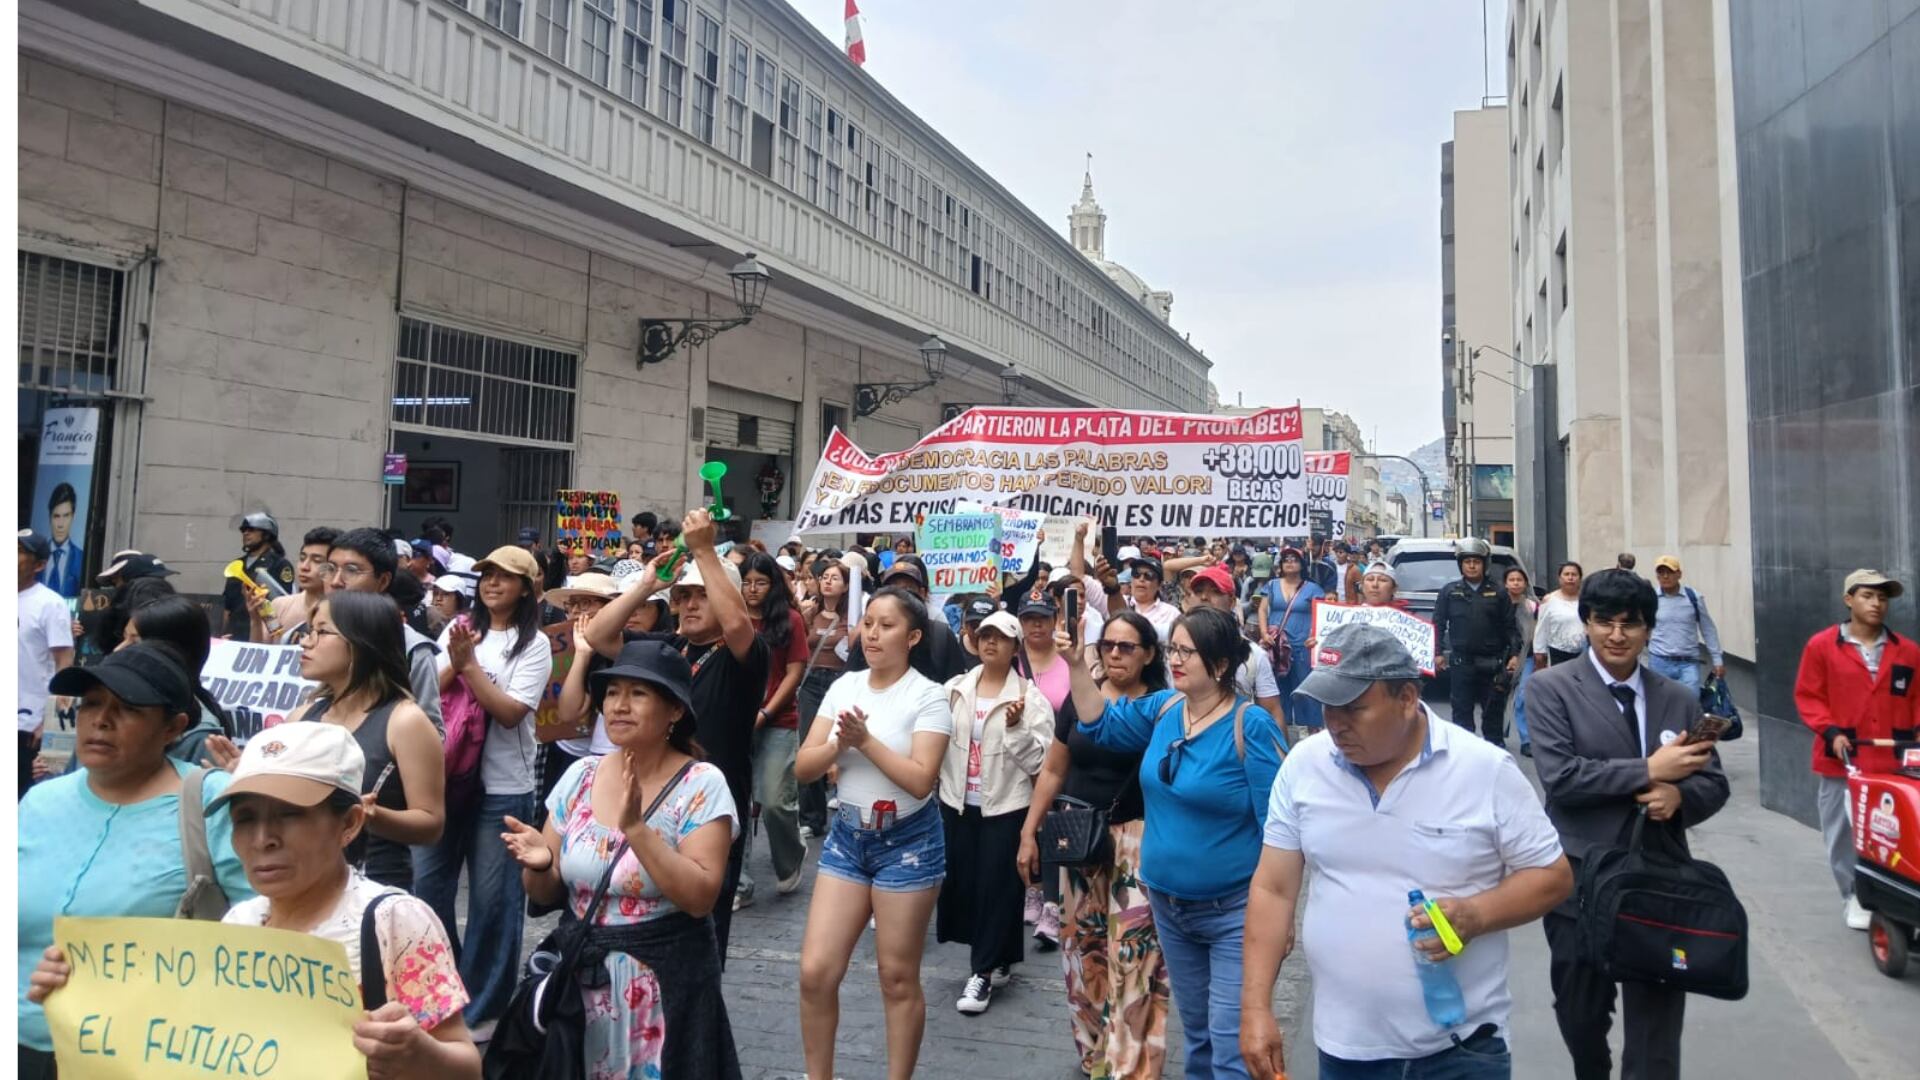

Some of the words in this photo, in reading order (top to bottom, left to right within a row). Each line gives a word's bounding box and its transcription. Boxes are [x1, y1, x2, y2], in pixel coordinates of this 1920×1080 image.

[932, 413, 1046, 437] EPARTIERON
[1049, 417, 1070, 437] LA
[1074, 417, 1132, 437] PLATA
[1138, 416, 1177, 436] DEL
[1183, 410, 1299, 436] PRONABEC?
[896, 448, 1021, 470] DEMOCRACIA
[1024, 450, 1060, 471] LAS
[1063, 448, 1169, 471] PALABRAS
[1203, 444, 1301, 481] +38,000
[865, 470, 995, 495] DOCUMENTOS
[999, 474, 1041, 493] HAN
[1043, 470, 1127, 495] PERDIDO
[1130, 475, 1212, 495] VALOR!
[1227, 479, 1282, 503] BECAS
[838, 497, 884, 526] MÁS
[889, 497, 968, 524] EXCUSA
[1125, 504, 1153, 527] ES
[1160, 504, 1192, 527] UN
[1199, 503, 1308, 528] DERECHO!
[928, 516, 996, 534] SEMBRAMOS
[934, 566, 999, 588] FUTURO
[231, 647, 269, 674] UN
[1856, 784, 1869, 851] Helados
[156, 946, 196, 988] NO
[215, 944, 355, 1008] RECORTES
[79, 1014, 117, 1057] EL
[144, 1018, 280, 1077] FUTURO
